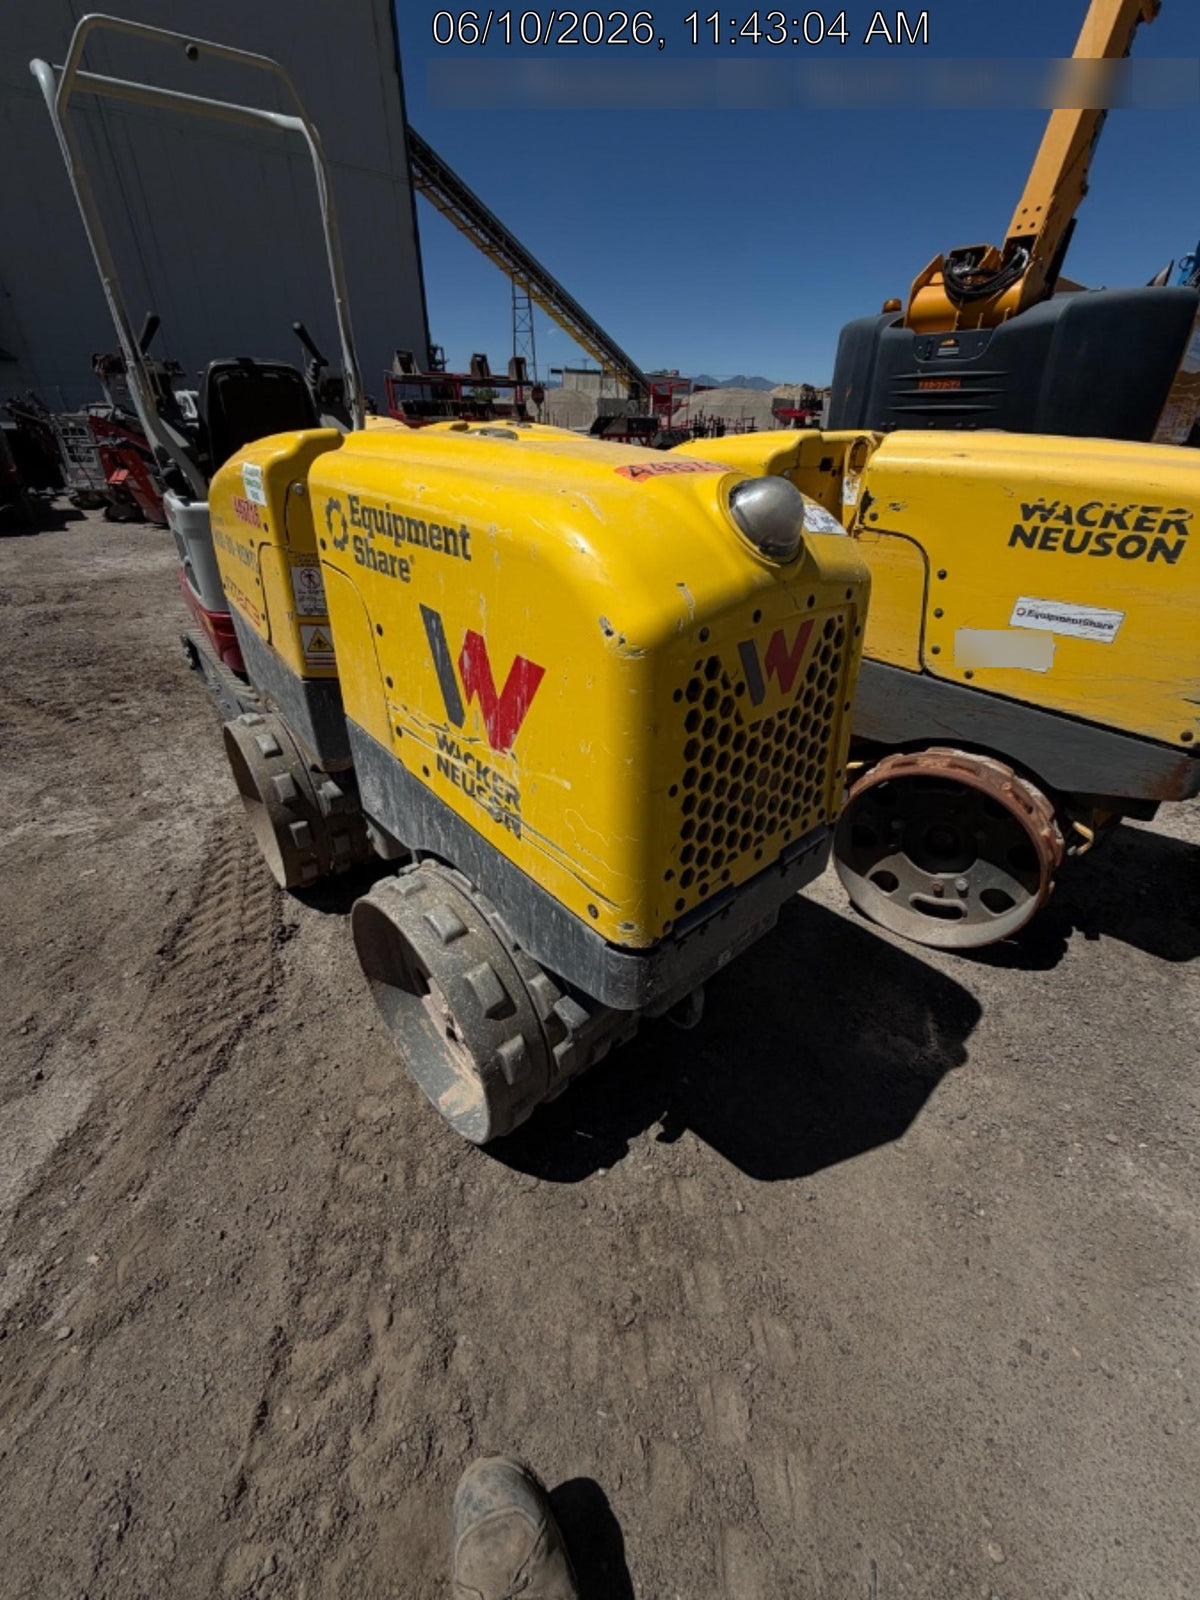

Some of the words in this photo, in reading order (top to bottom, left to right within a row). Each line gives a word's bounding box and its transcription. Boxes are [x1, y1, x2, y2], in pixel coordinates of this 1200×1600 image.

[348, 494, 471, 561] Equipment
[1020, 498, 1193, 535] WACKER
[353, 535, 411, 583] Share
[1008, 525, 1186, 564] NEUSON
[1027, 608, 1114, 630] EquipmentShare
